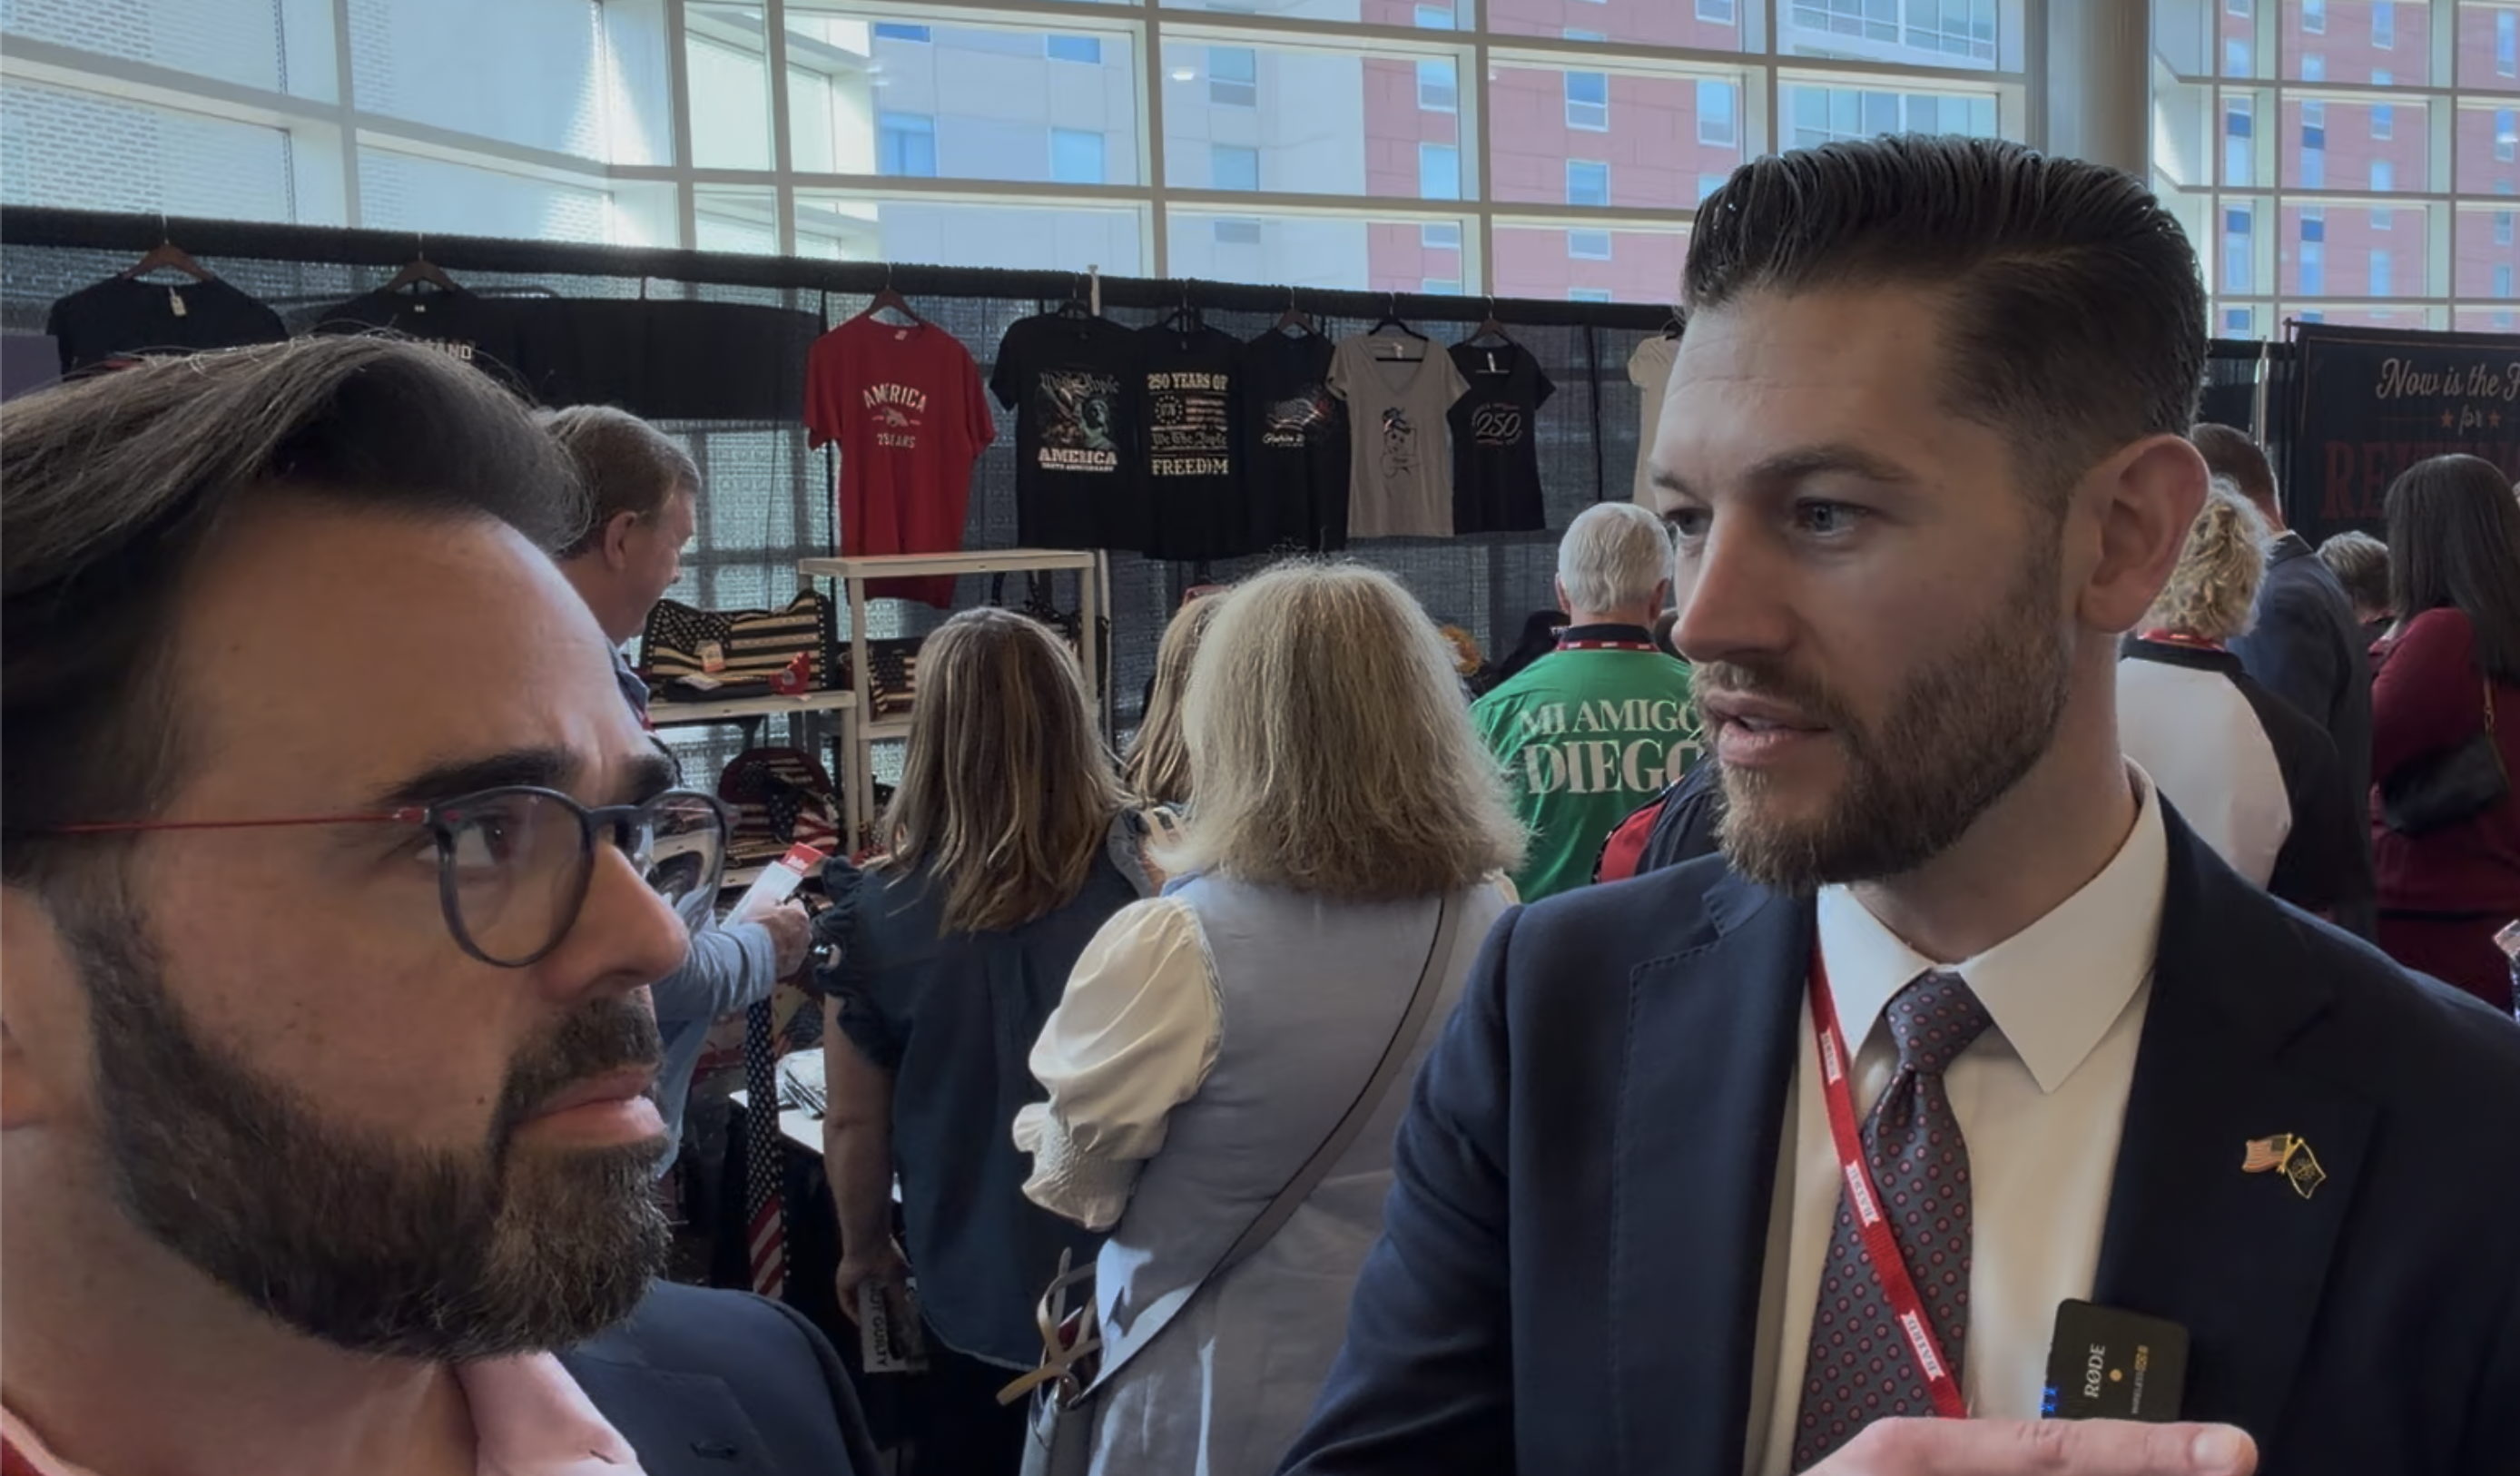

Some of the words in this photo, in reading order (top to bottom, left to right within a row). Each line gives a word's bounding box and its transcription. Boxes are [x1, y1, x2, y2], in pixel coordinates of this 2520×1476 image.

[1147, 372, 1172, 390] 250
[1171, 372, 1211, 389] YEARS
[2376, 358, 2440, 399] Now
[2442, 366, 2463, 397] is
[2466, 363, 2501, 398] the
[1475, 412, 1521, 438] 250
[2458, 404, 2484, 436] for
[1038, 447, 1118, 466] AMERICA
[1520, 702, 1568, 736] MI
